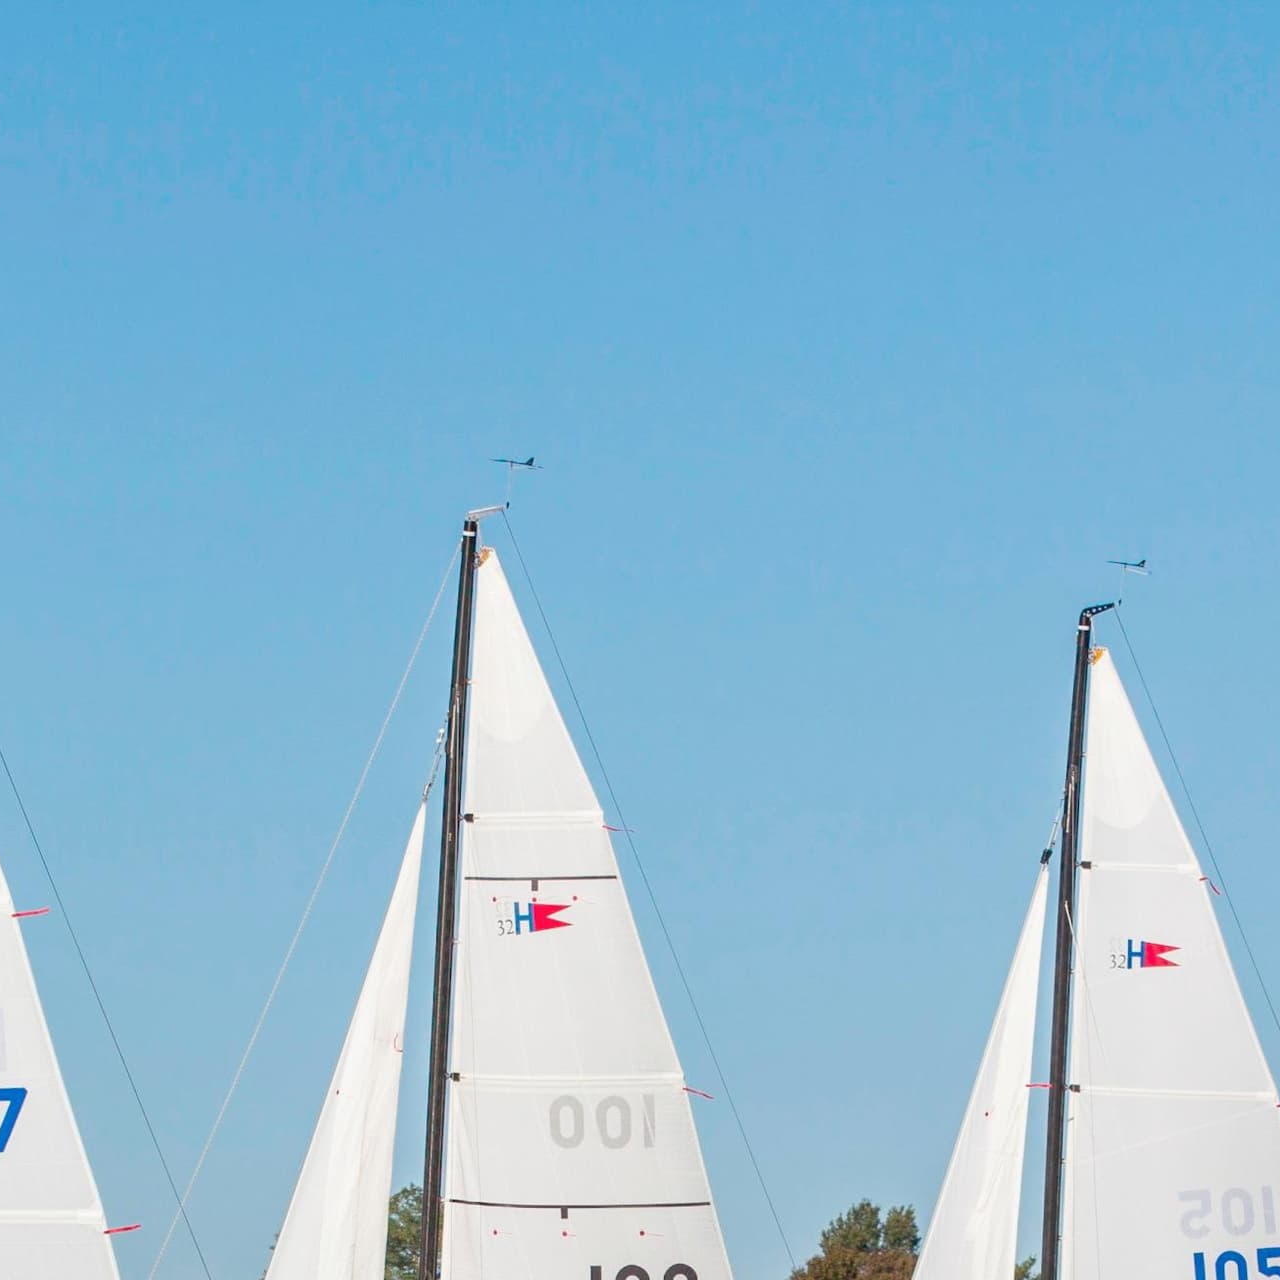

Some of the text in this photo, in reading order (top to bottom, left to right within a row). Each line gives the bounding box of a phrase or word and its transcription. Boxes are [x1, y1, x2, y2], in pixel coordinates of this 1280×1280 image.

[497, 919, 514, 937] 32
[513, 901, 535, 936] H
[1110, 939, 1145, 970] 32 H
